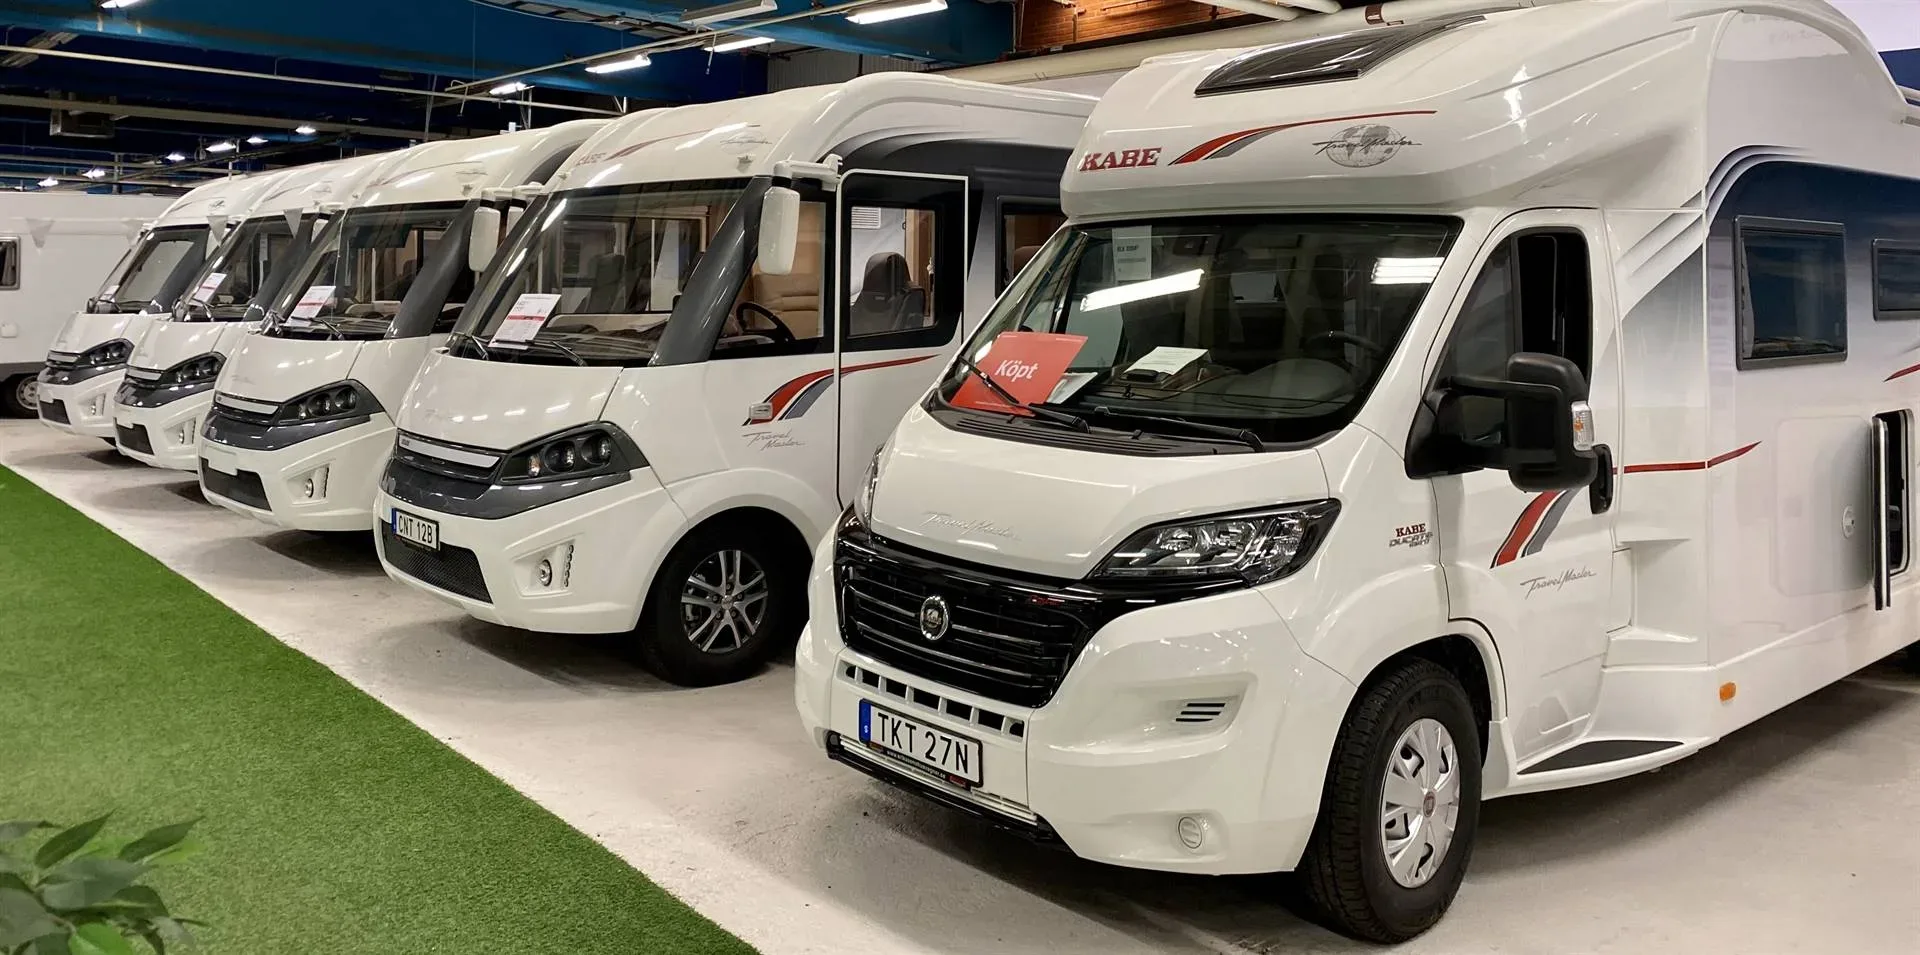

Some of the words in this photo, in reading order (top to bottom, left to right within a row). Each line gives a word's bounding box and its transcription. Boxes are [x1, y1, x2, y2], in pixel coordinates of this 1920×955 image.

[1079, 147, 1162, 172] KABE
[994, 359, 1039, 382] Köpt
[398, 515, 414, 537] CNT
[416, 521, 433, 544] 12B
[1395, 523, 1426, 537] KABE
[877, 712, 917, 753] TKT
[924, 731, 968, 774] 27N
